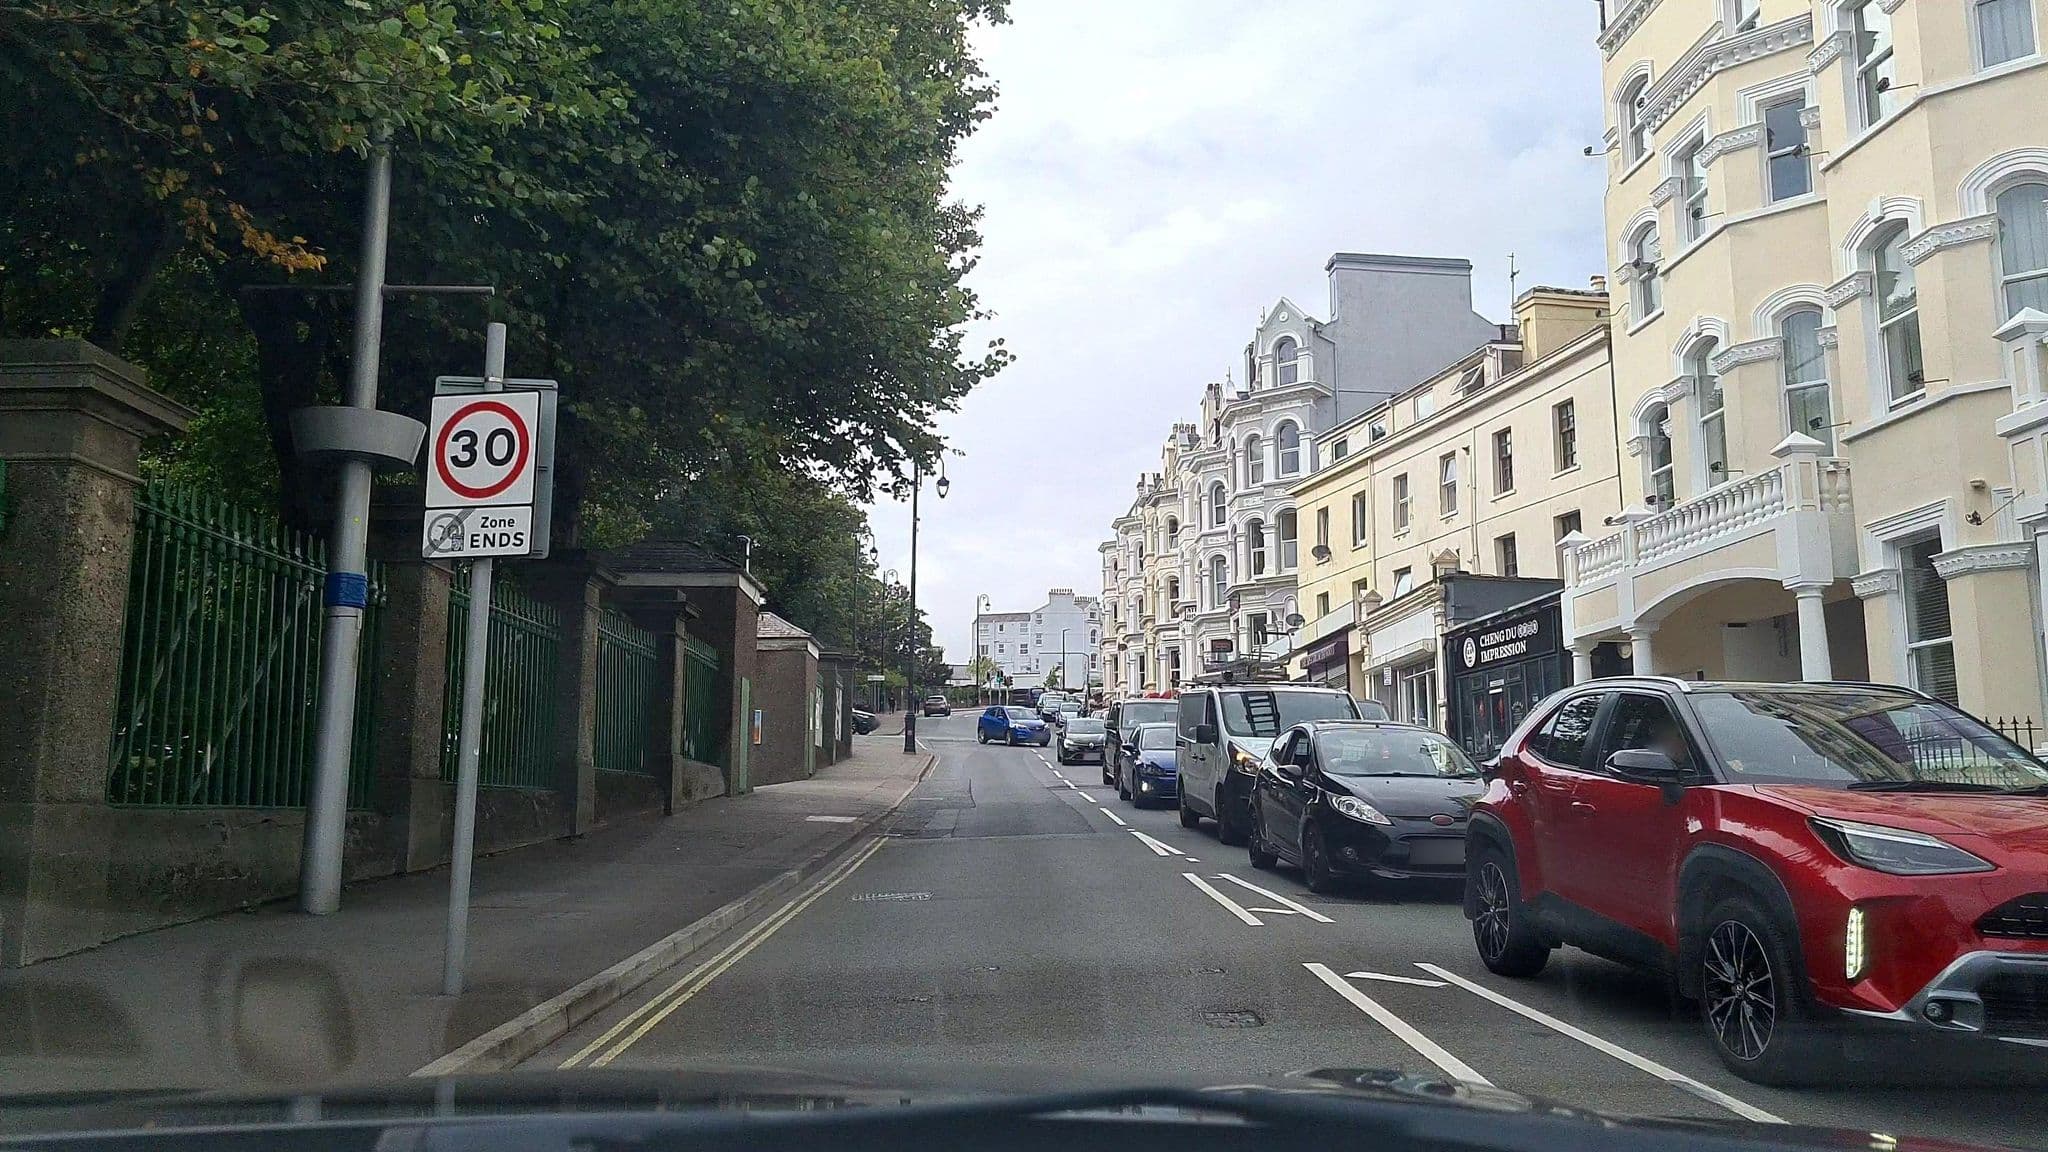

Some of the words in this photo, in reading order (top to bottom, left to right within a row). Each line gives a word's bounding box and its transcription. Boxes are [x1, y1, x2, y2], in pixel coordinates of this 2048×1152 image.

[450, 428, 516, 469] 30
[480, 516, 515, 529] Zone
[470, 532, 524, 548] ENDS
[1480, 630, 1505, 647] CHENG
[1505, 626, 1517, 641] DU
[1480, 640, 1527, 663] IMPRESSION
